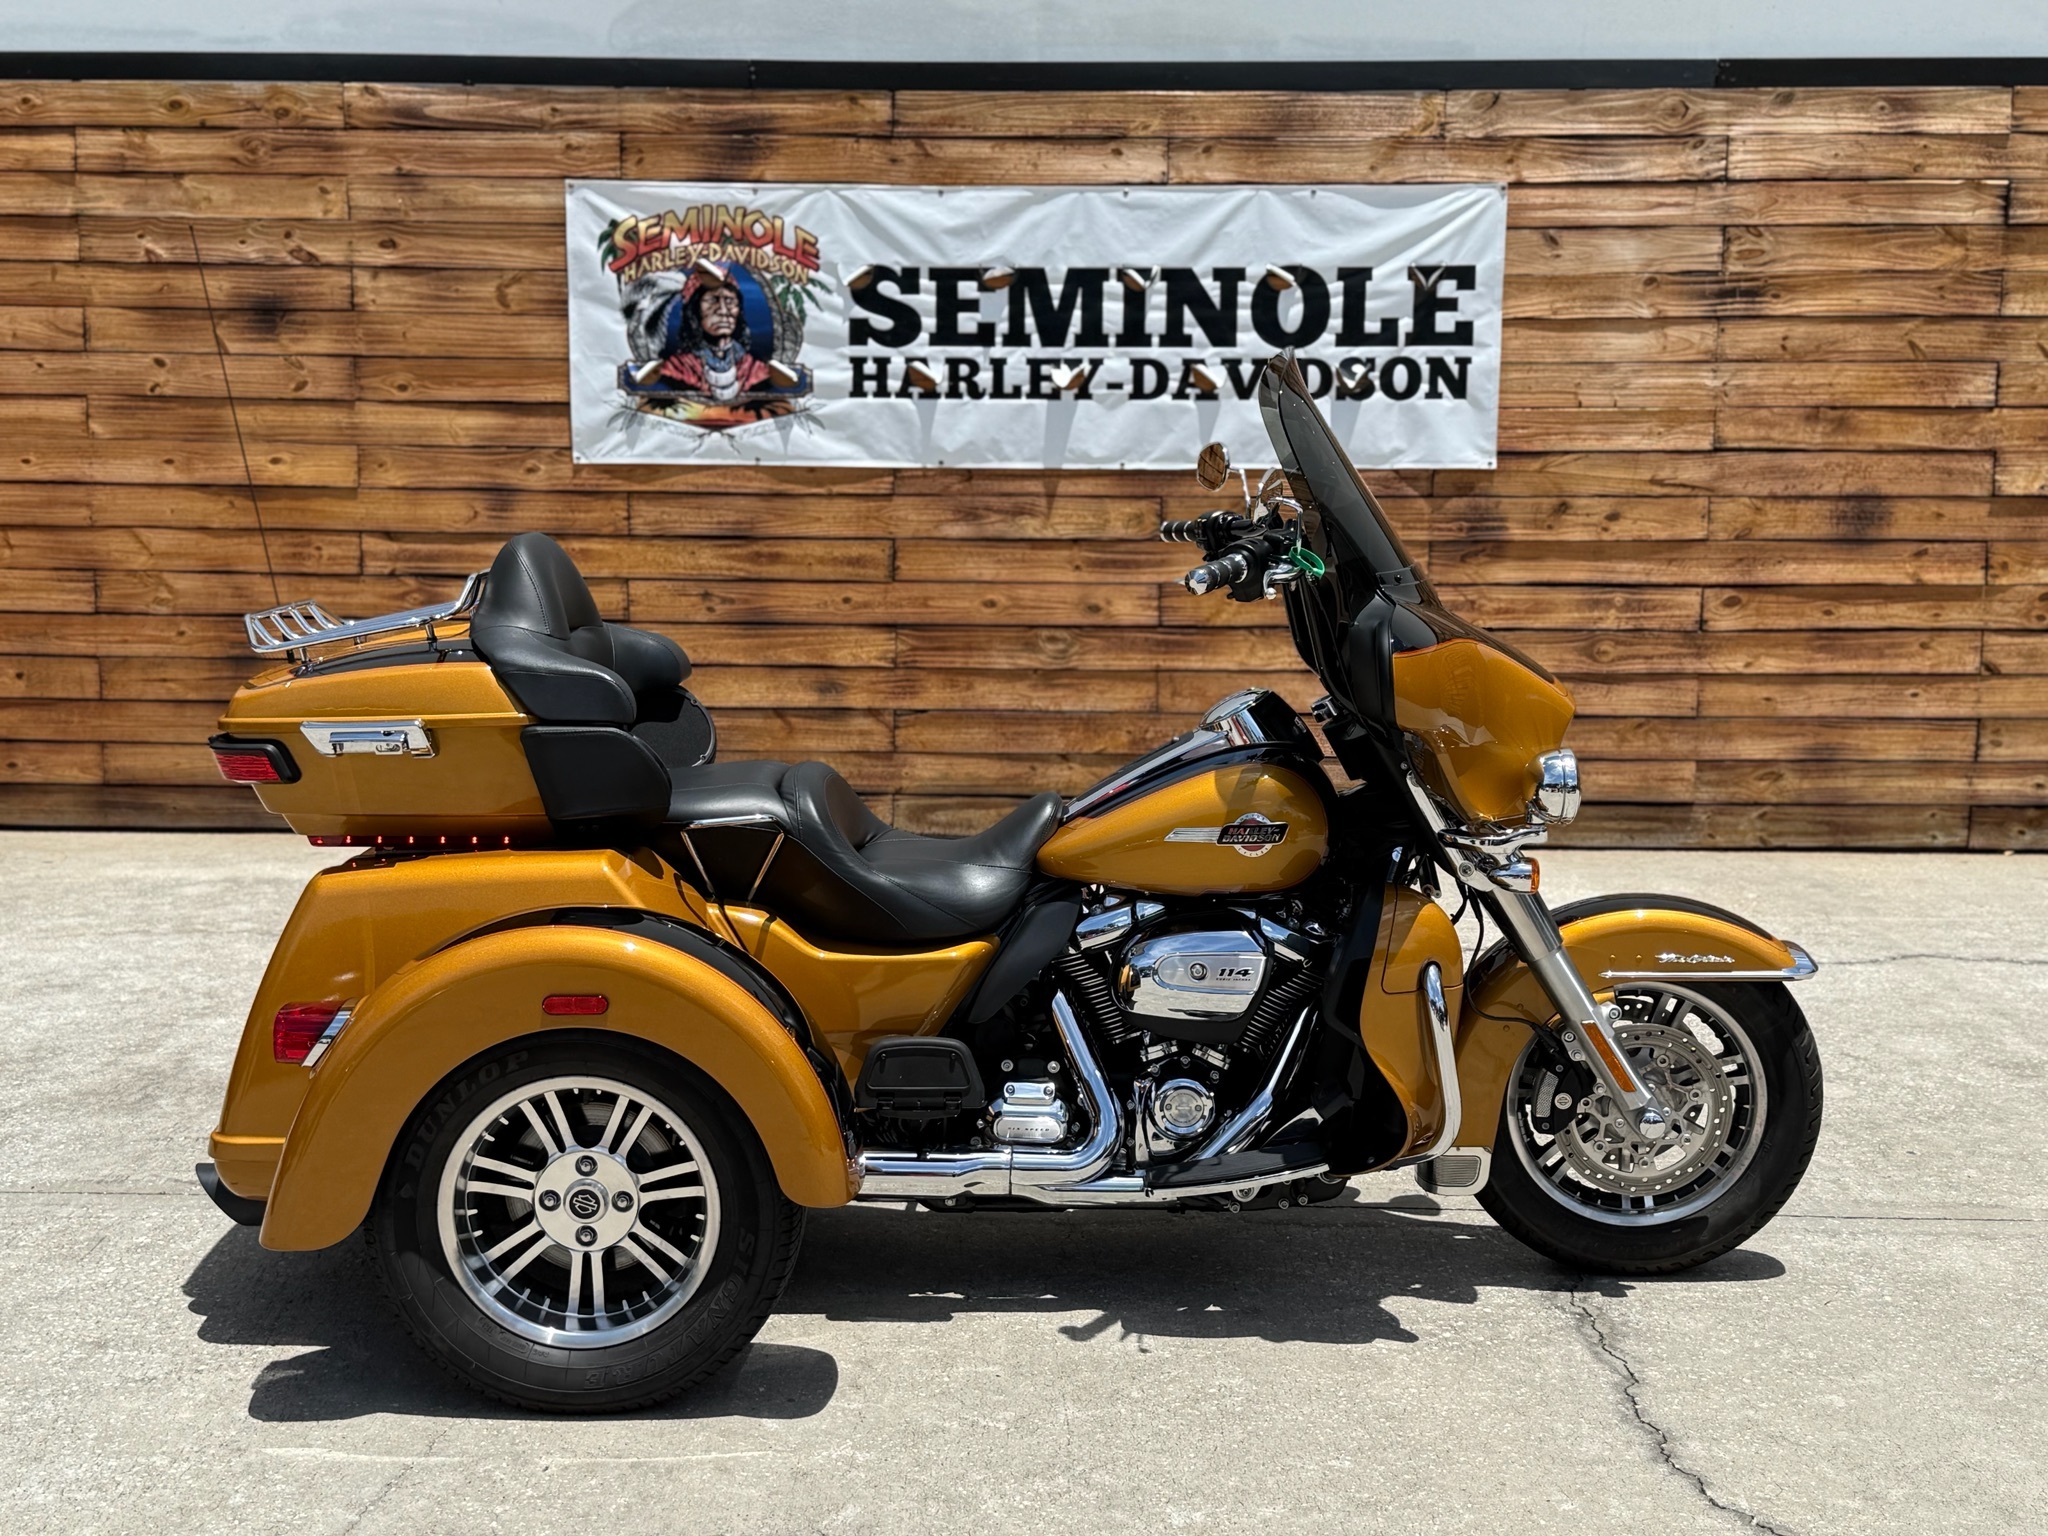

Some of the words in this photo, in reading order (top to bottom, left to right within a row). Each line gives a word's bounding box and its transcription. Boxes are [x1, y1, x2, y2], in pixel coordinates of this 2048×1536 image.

[608, 204, 820, 273] SEMINOLE
[623, 242, 809, 284] HARLEY-DAVIDSON
[848, 264, 1477, 348] SEMINOLE
[848, 356, 1472, 400] HARLEY-DAVDSON
[1222, 833, 1281, 843] DAVIDSON
[1218, 968, 1252, 977] 114
[402, 1048, 529, 1172] DUNLOP
